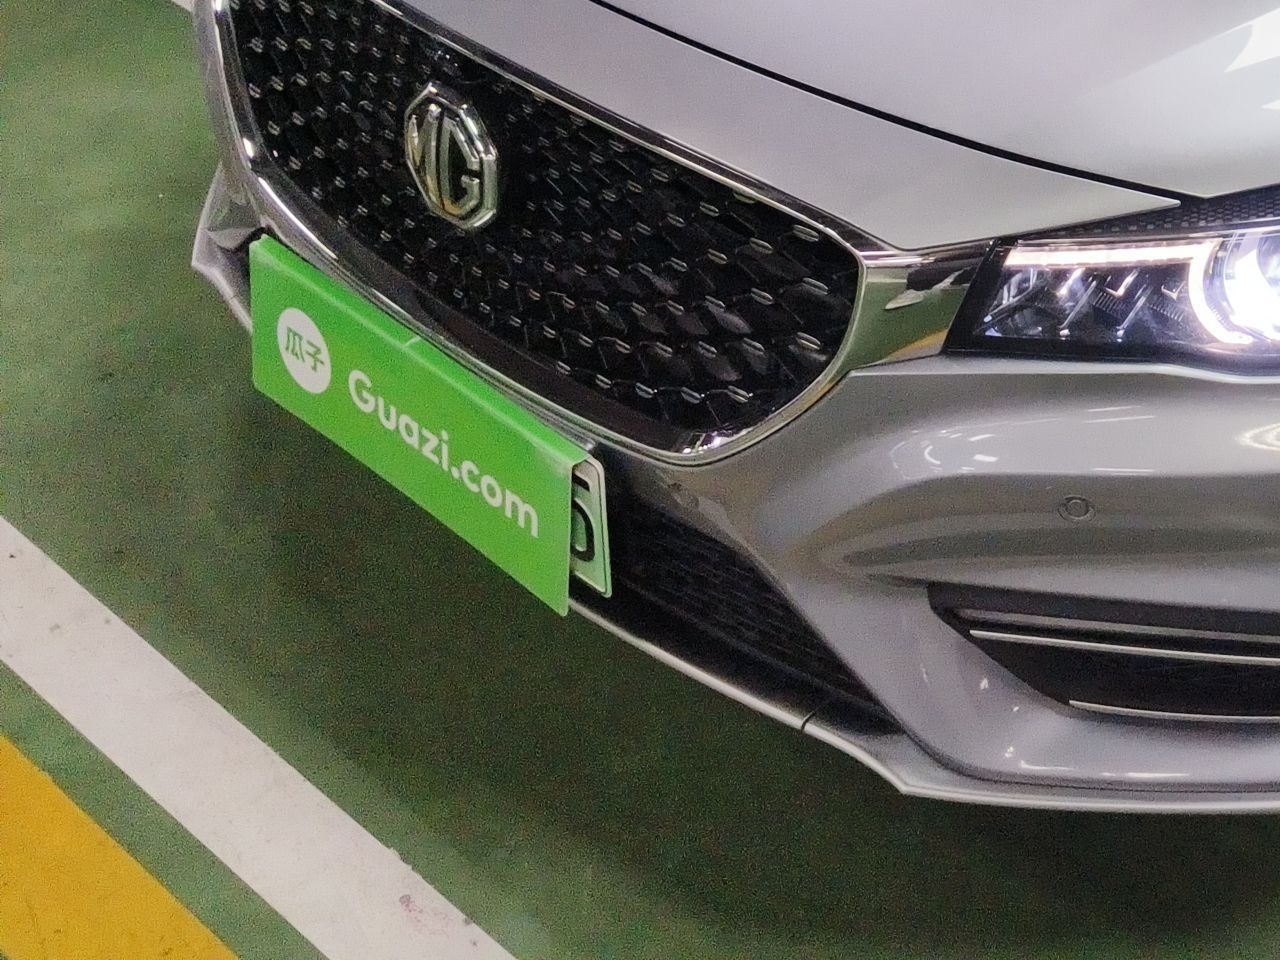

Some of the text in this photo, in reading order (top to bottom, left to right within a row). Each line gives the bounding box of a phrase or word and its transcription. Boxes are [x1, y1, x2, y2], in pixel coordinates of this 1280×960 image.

[405, 100, 483, 218] MG
[284, 326, 325, 373] 瓜子
[348, 369, 540, 539] Guazi.com
